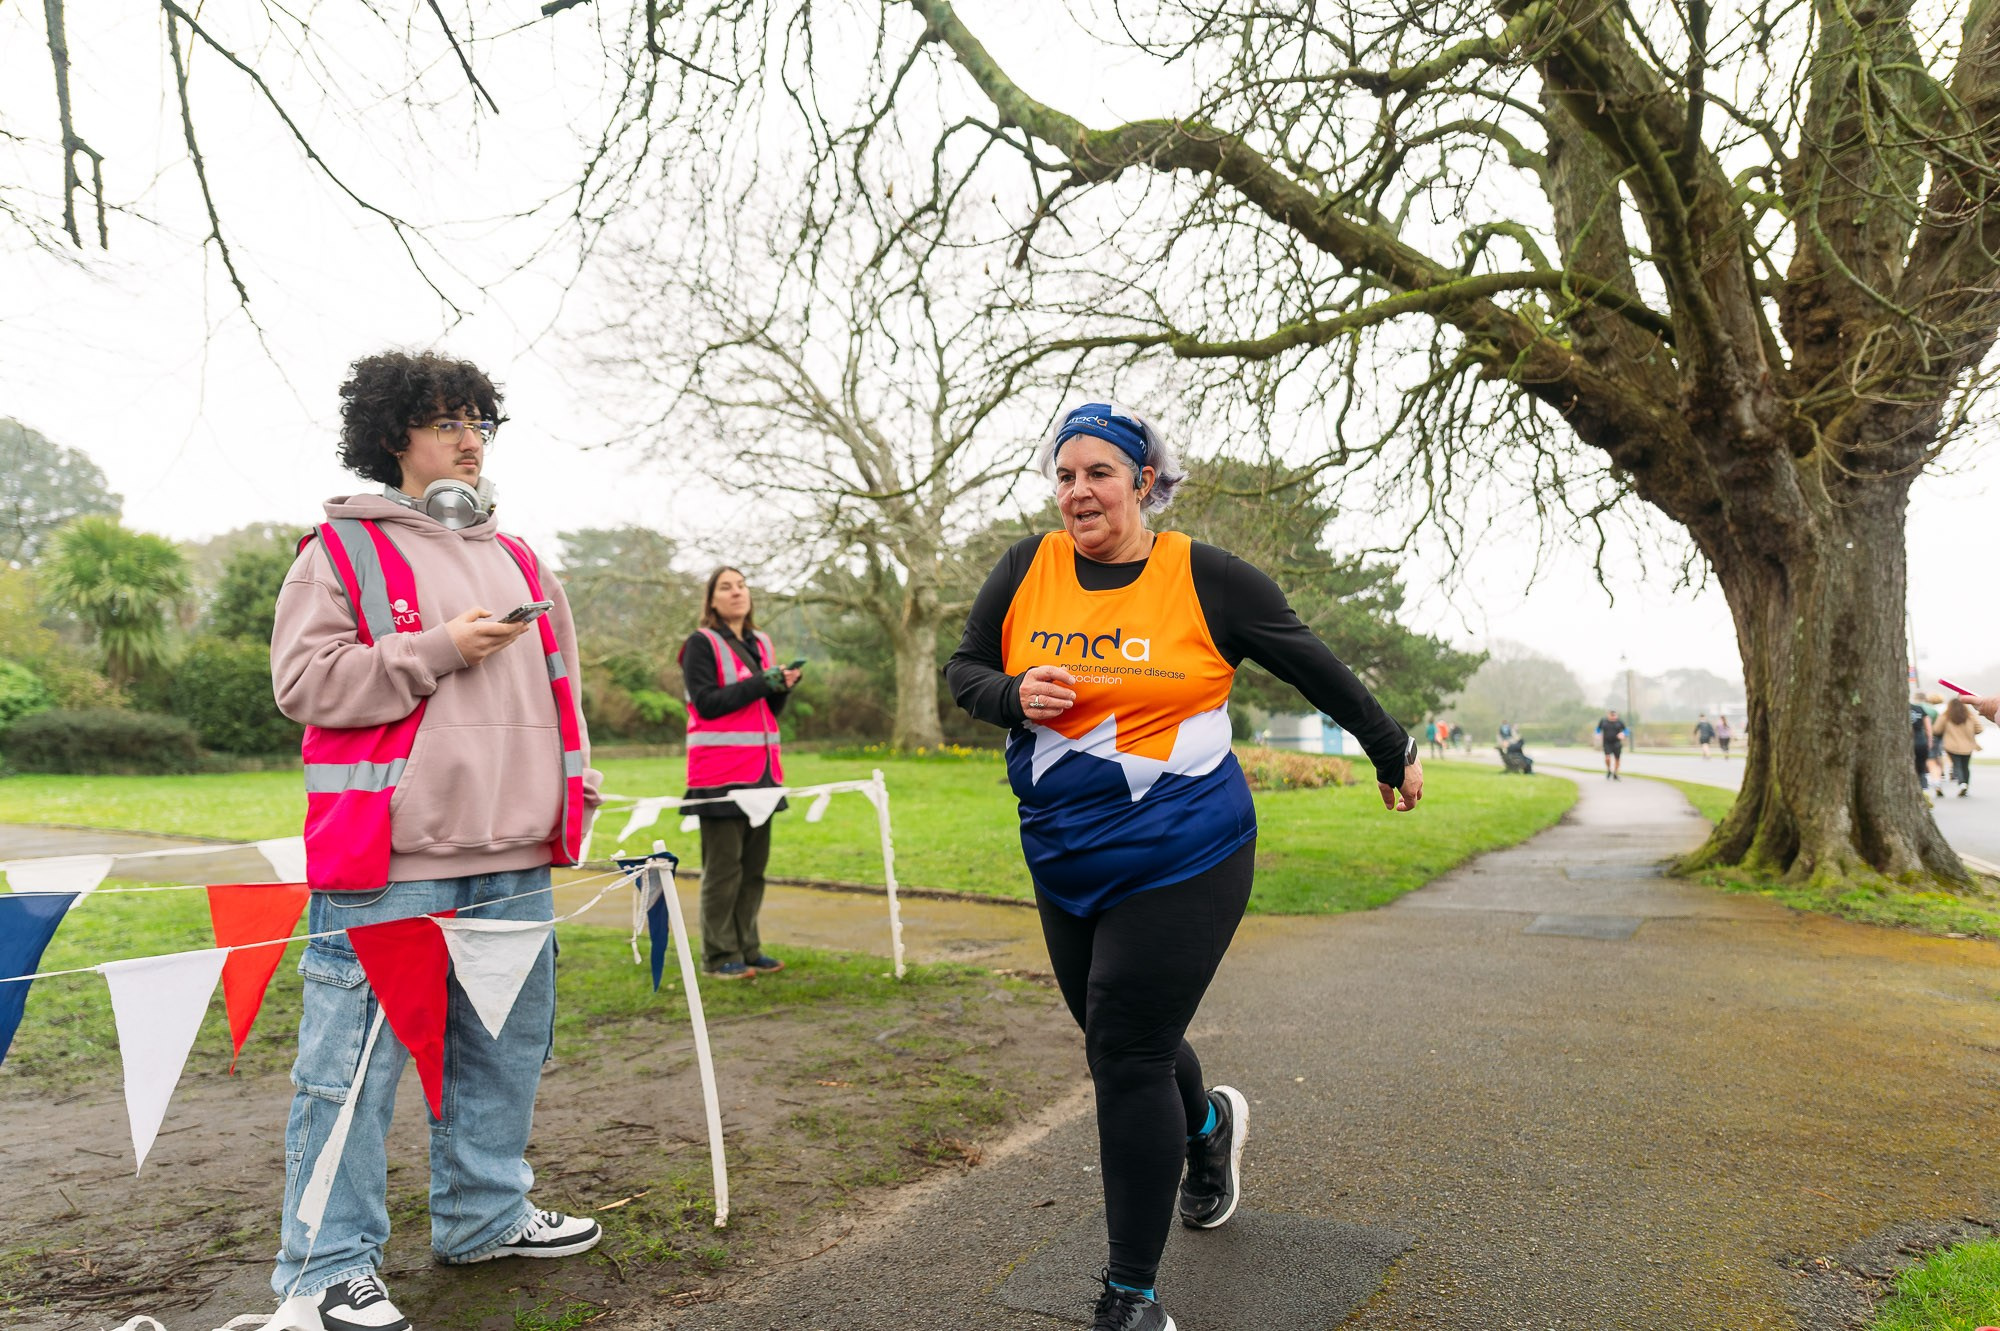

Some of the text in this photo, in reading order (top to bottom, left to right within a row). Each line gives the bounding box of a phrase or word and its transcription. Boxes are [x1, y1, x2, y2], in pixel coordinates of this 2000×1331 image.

[1030, 628, 1149, 661] mnda
[1094, 665, 1142, 676] neurone
[1144, 667, 1186, 680] disease
